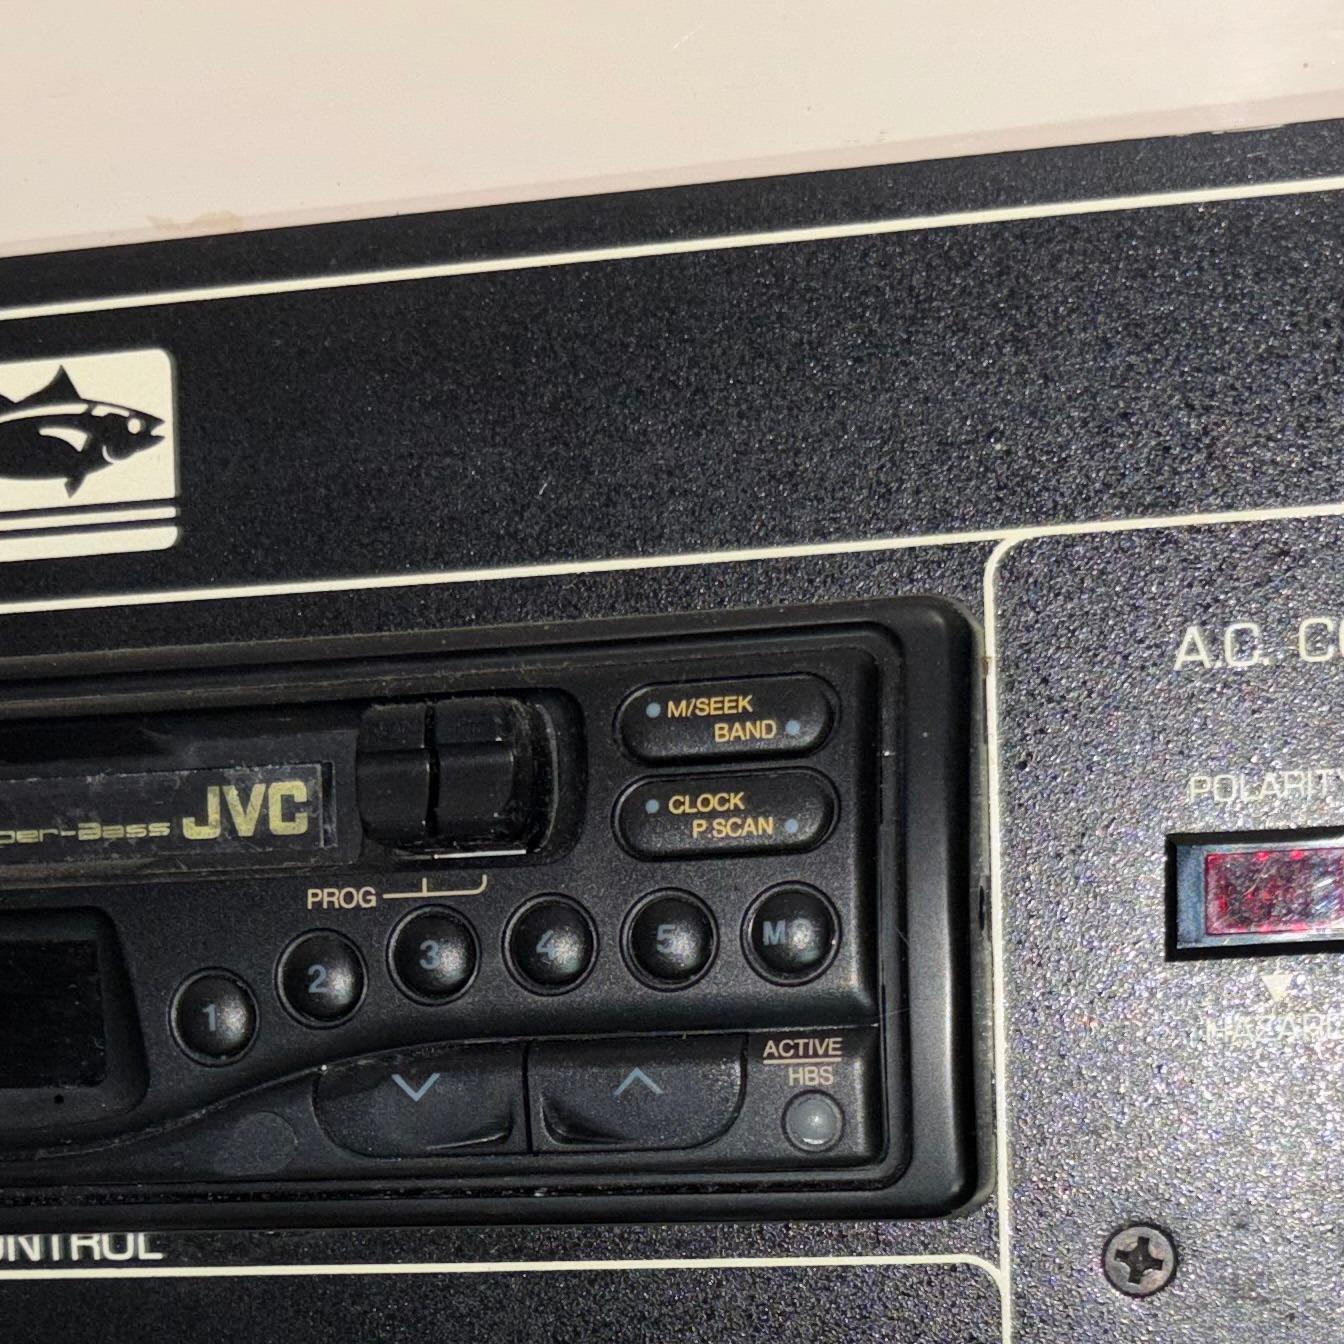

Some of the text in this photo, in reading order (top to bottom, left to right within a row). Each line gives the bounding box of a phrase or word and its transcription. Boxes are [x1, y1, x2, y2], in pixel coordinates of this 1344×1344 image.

[1174, 621, 1270, 671] A.C.
[667, 695, 753, 718] M/SEEK
[715, 720, 777, 742] BAND
[183, 780, 307, 840] JVC
[669, 793, 745, 813] CLOCK
[307, 888, 376, 909] PROG
[536, 928, 559, 960] 4
[657, 923, 678, 953] 5
[419, 939, 440, 969] 3
[308, 965, 327, 994] 2
[203, 1004, 218, 1030] 1
[763, 1037, 843, 1057] ACTIVE
[788, 1065, 833, 1086] HBS
